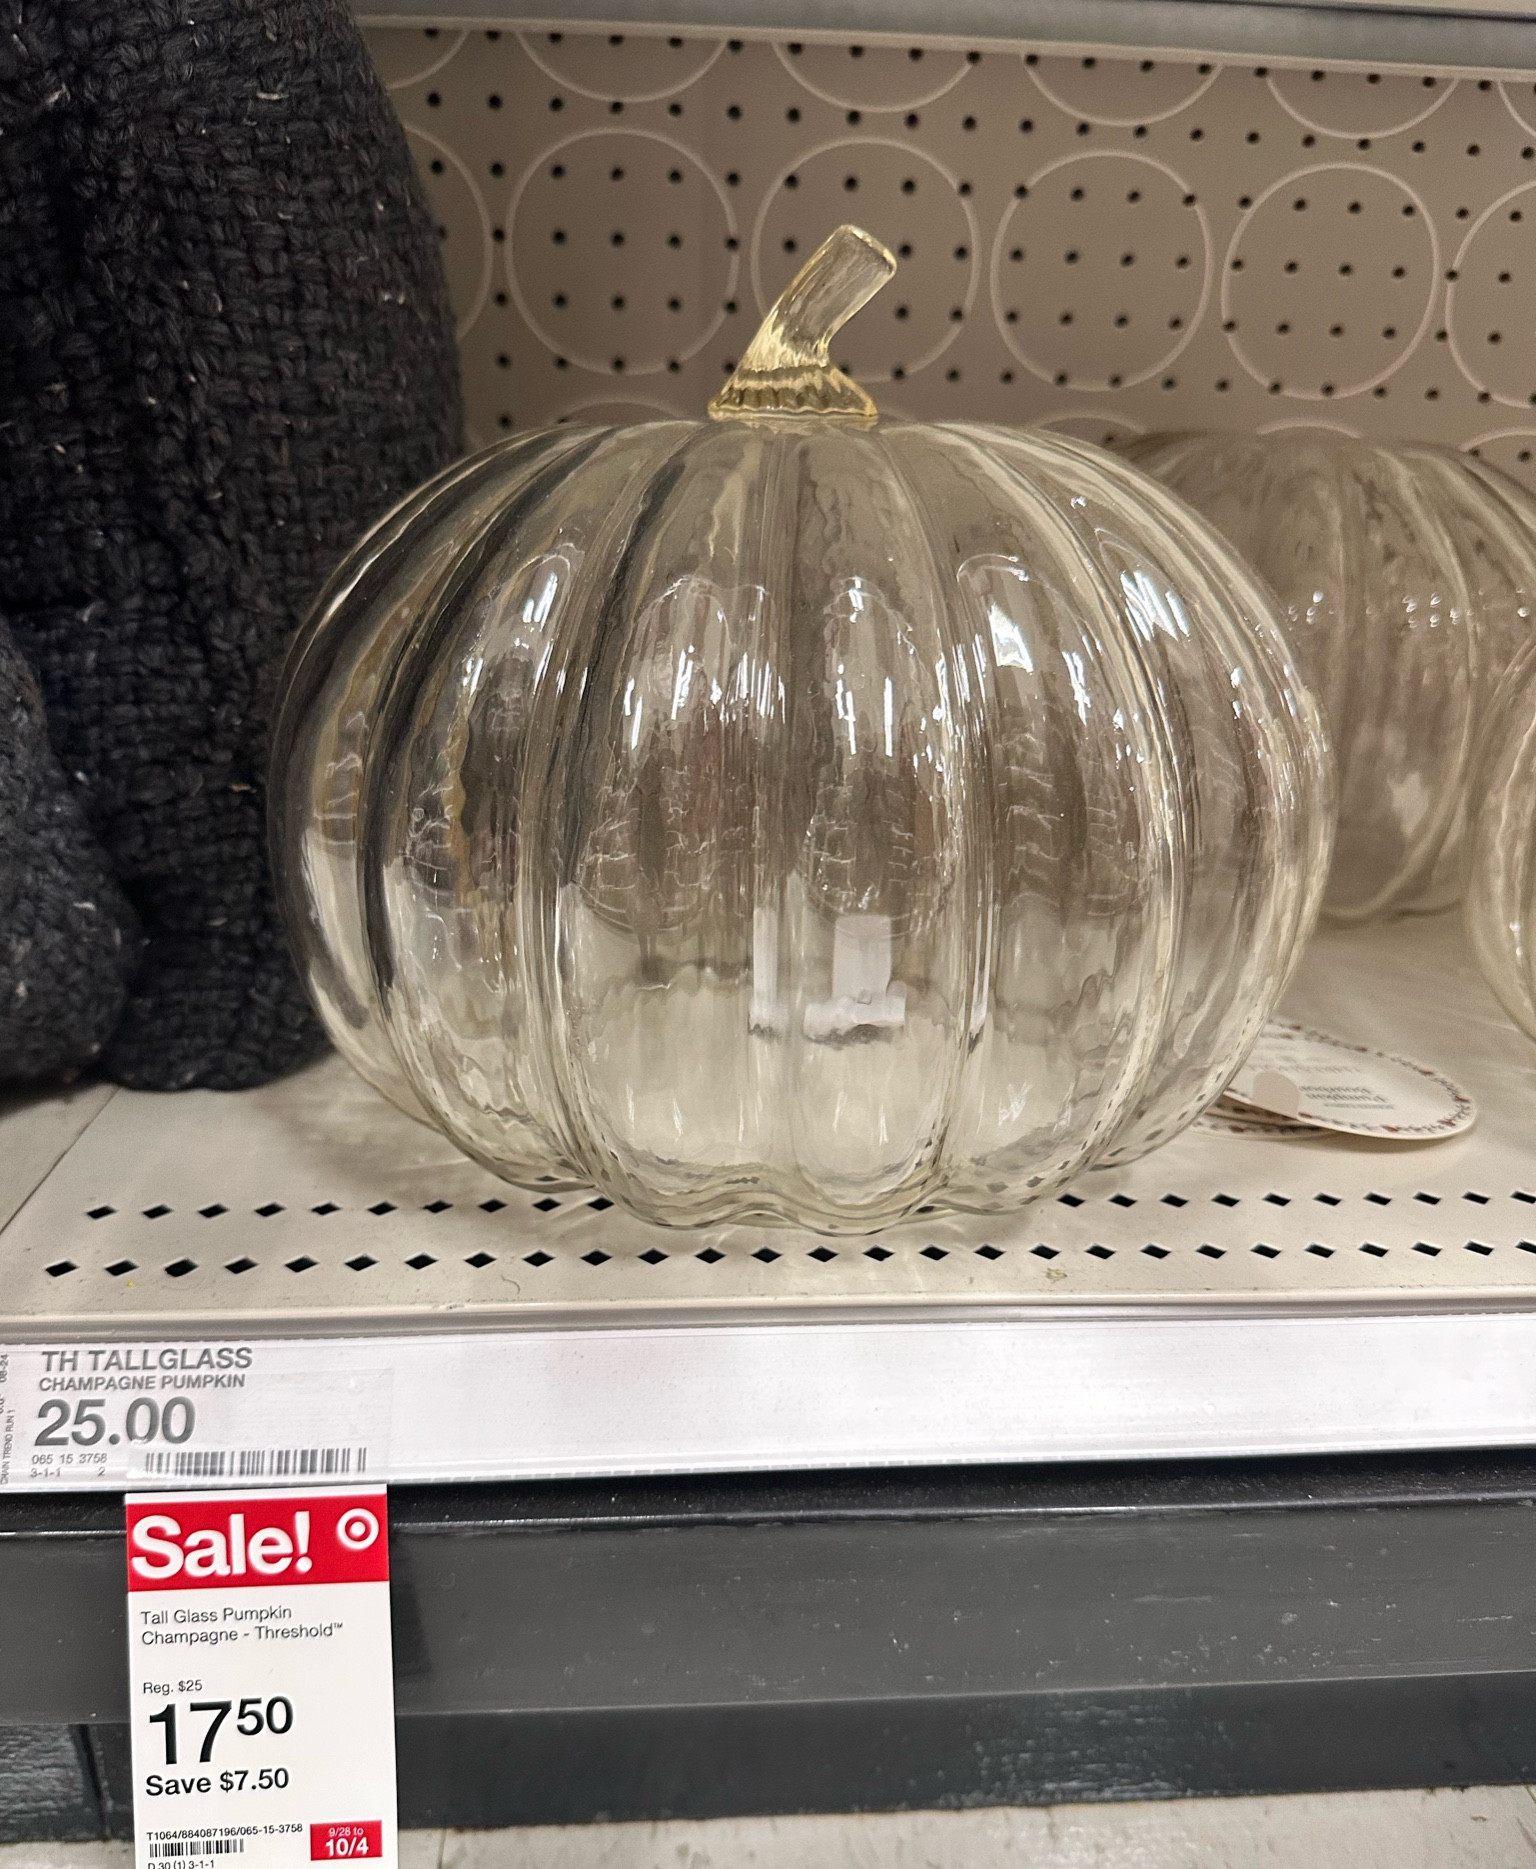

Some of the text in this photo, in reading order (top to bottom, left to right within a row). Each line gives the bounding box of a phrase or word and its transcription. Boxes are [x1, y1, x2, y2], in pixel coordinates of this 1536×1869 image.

[41, 1347, 254, 1372] TH TALLGLASS
[39, 1373, 246, 1391] CHAMPAGNE PUMPKIN
[5, 1415, 15, 1432] RUN
[34, 1396, 196, 1446] 25.00
[3, 1433, 13, 1460] TREND
[31, 1452, 108, 1465] 065 15 3758
[30, 1466, 106, 1478] 3-1-1 2
[131, 1510, 313, 1579] Sale!
[141, 1604, 292, 1625] Tall Glass Pumpkin
[141, 1628, 238, 1646] Champagne
[143, 1679, 203, 1696] Reg. $25
[145, 1767, 290, 1796] Save $7.50
[146, 1822, 303, 1841] T1064/884087196/065-15-3758
[328, 1826, 364, 1837] 9/28 to
[324, 1838, 369, 1857] 10/4
[188, 1859, 215, 1869] 3-1-1
